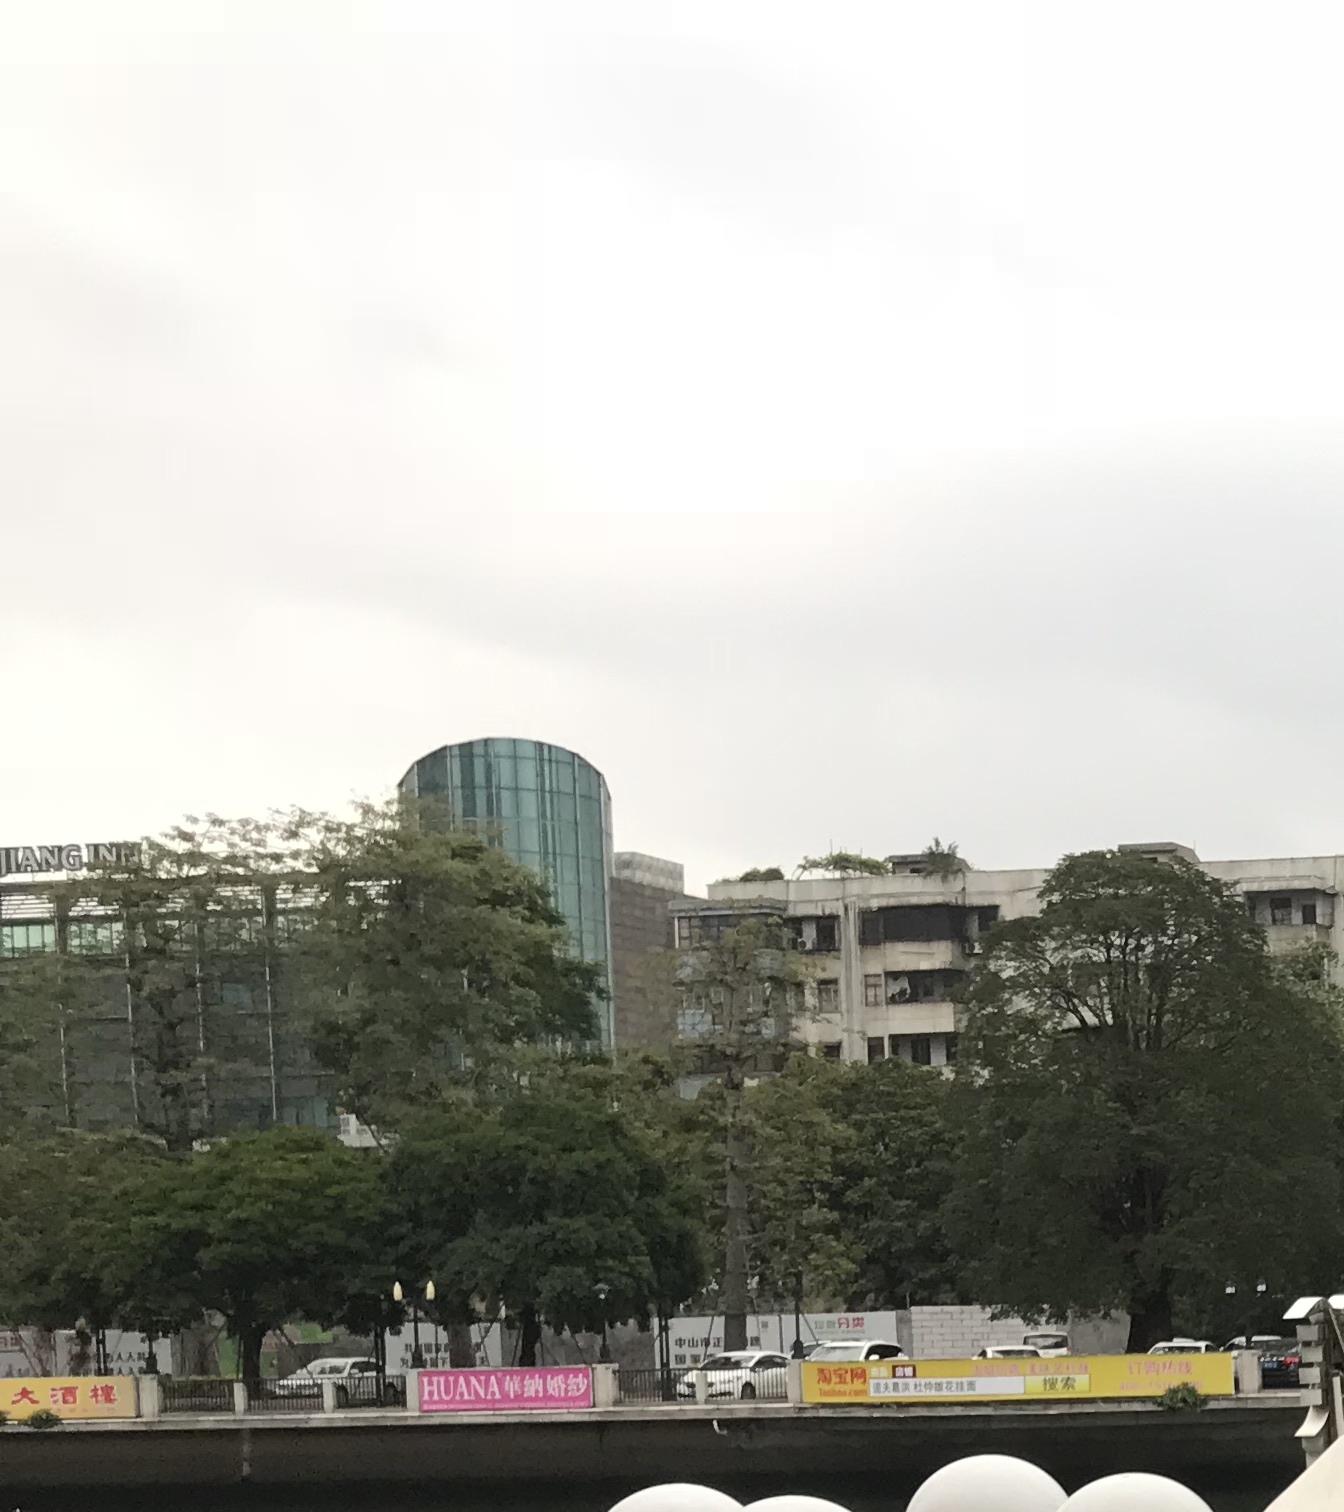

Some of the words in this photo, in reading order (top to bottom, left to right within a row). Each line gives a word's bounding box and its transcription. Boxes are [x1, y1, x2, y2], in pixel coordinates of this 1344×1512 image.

[816, 1366, 867, 1386] 淘宝网
[1042, 1376, 1076, 1392] 搜索
[422, 1375, 501, 1401] HUANA
